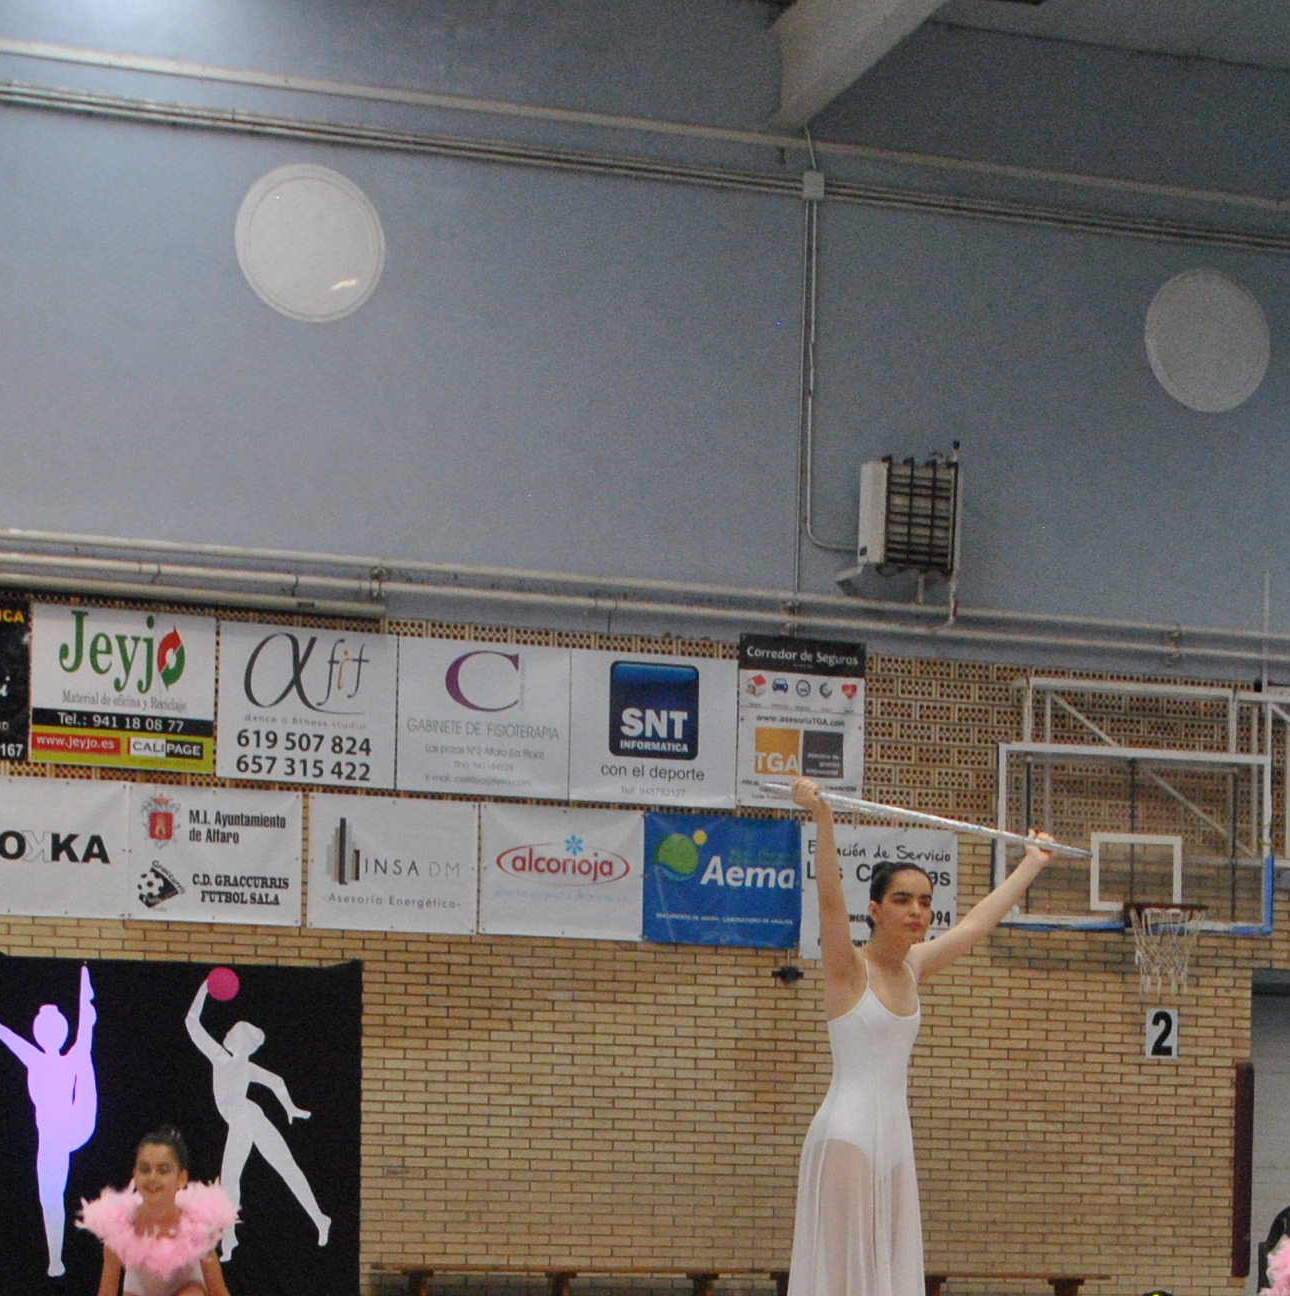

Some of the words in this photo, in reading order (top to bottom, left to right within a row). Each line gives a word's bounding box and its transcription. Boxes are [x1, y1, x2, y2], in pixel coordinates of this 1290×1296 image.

[59, 609, 185, 694] Jeyjo
[746, 645, 797, 661] Corredor
[800, 650, 813, 662] de
[816, 651, 859, 667] Seguros
[62, 690, 98, 706] Material
[93, 714, 118, 728] 941
[125, 717, 141, 729] 18
[146, 718, 162, 731] 08
[168, 720, 184, 733] 77
[245, 713, 277, 725] dance
[620, 707, 688, 740] SNT
[406, 717, 462, 735] GABINETE
[466, 722, 481, 736] DE
[487, 723, 559, 741] FISIOTERAPIA
[0, 743, 23, 757] 167
[36, 734, 115, 750] www.jeyjo.es
[132, 741, 202, 756] CALIPAGE
[237, 729, 278, 749] 619
[285, 732, 325, 753] 507
[331, 736, 372, 756] 824
[620, 739, 689, 753] INFORMATICA
[236, 754, 277, 775] 657
[284, 758, 324, 778] 315
[331, 761, 370, 782] 422
[755, 751, 799, 773] TGA
[601, 764, 627, 777] con
[633, 764, 645, 777] el
[649, 766, 705, 782] deporte
[189, 810, 210, 825] M.I.
[214, 811, 286, 829] Ayuntamiento
[189, 828, 201, 842] de
[206, 828, 239, 844] Alfaro
[873, 845, 890, 858] de
[896, 845, 951, 862] Servicio
[365, 858, 419, 877] INSA
[428, 861, 460, 878] DM
[700, 855, 795, 889] Aema
[192, 873, 213, 885] C.D.
[215, 874, 289, 890] GRACCURRIS
[200, 890, 247, 904] FUTBOL
[249, 892, 280, 906] SALA
[1151, 1010, 1173, 1057] 2
